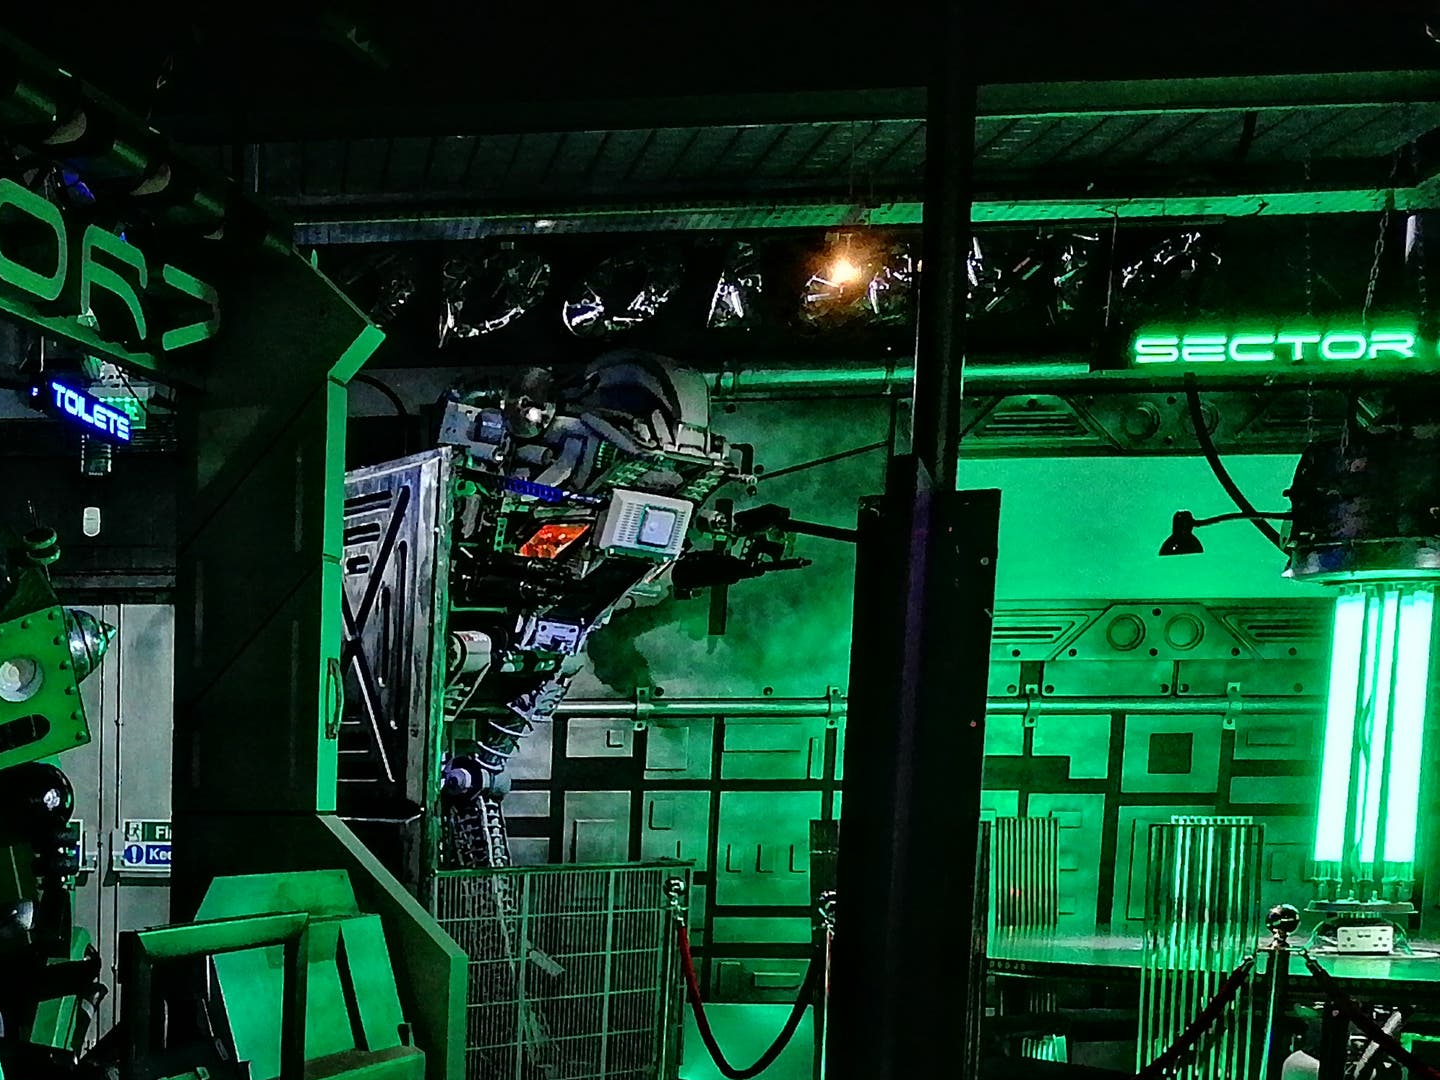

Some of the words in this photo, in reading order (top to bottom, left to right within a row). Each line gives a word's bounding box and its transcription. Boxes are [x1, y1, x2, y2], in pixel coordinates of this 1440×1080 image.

[1135, 334, 1416, 362] SECTOR
[52, 381, 130, 441] TOILETS
[155, 825, 172, 840] Fi
